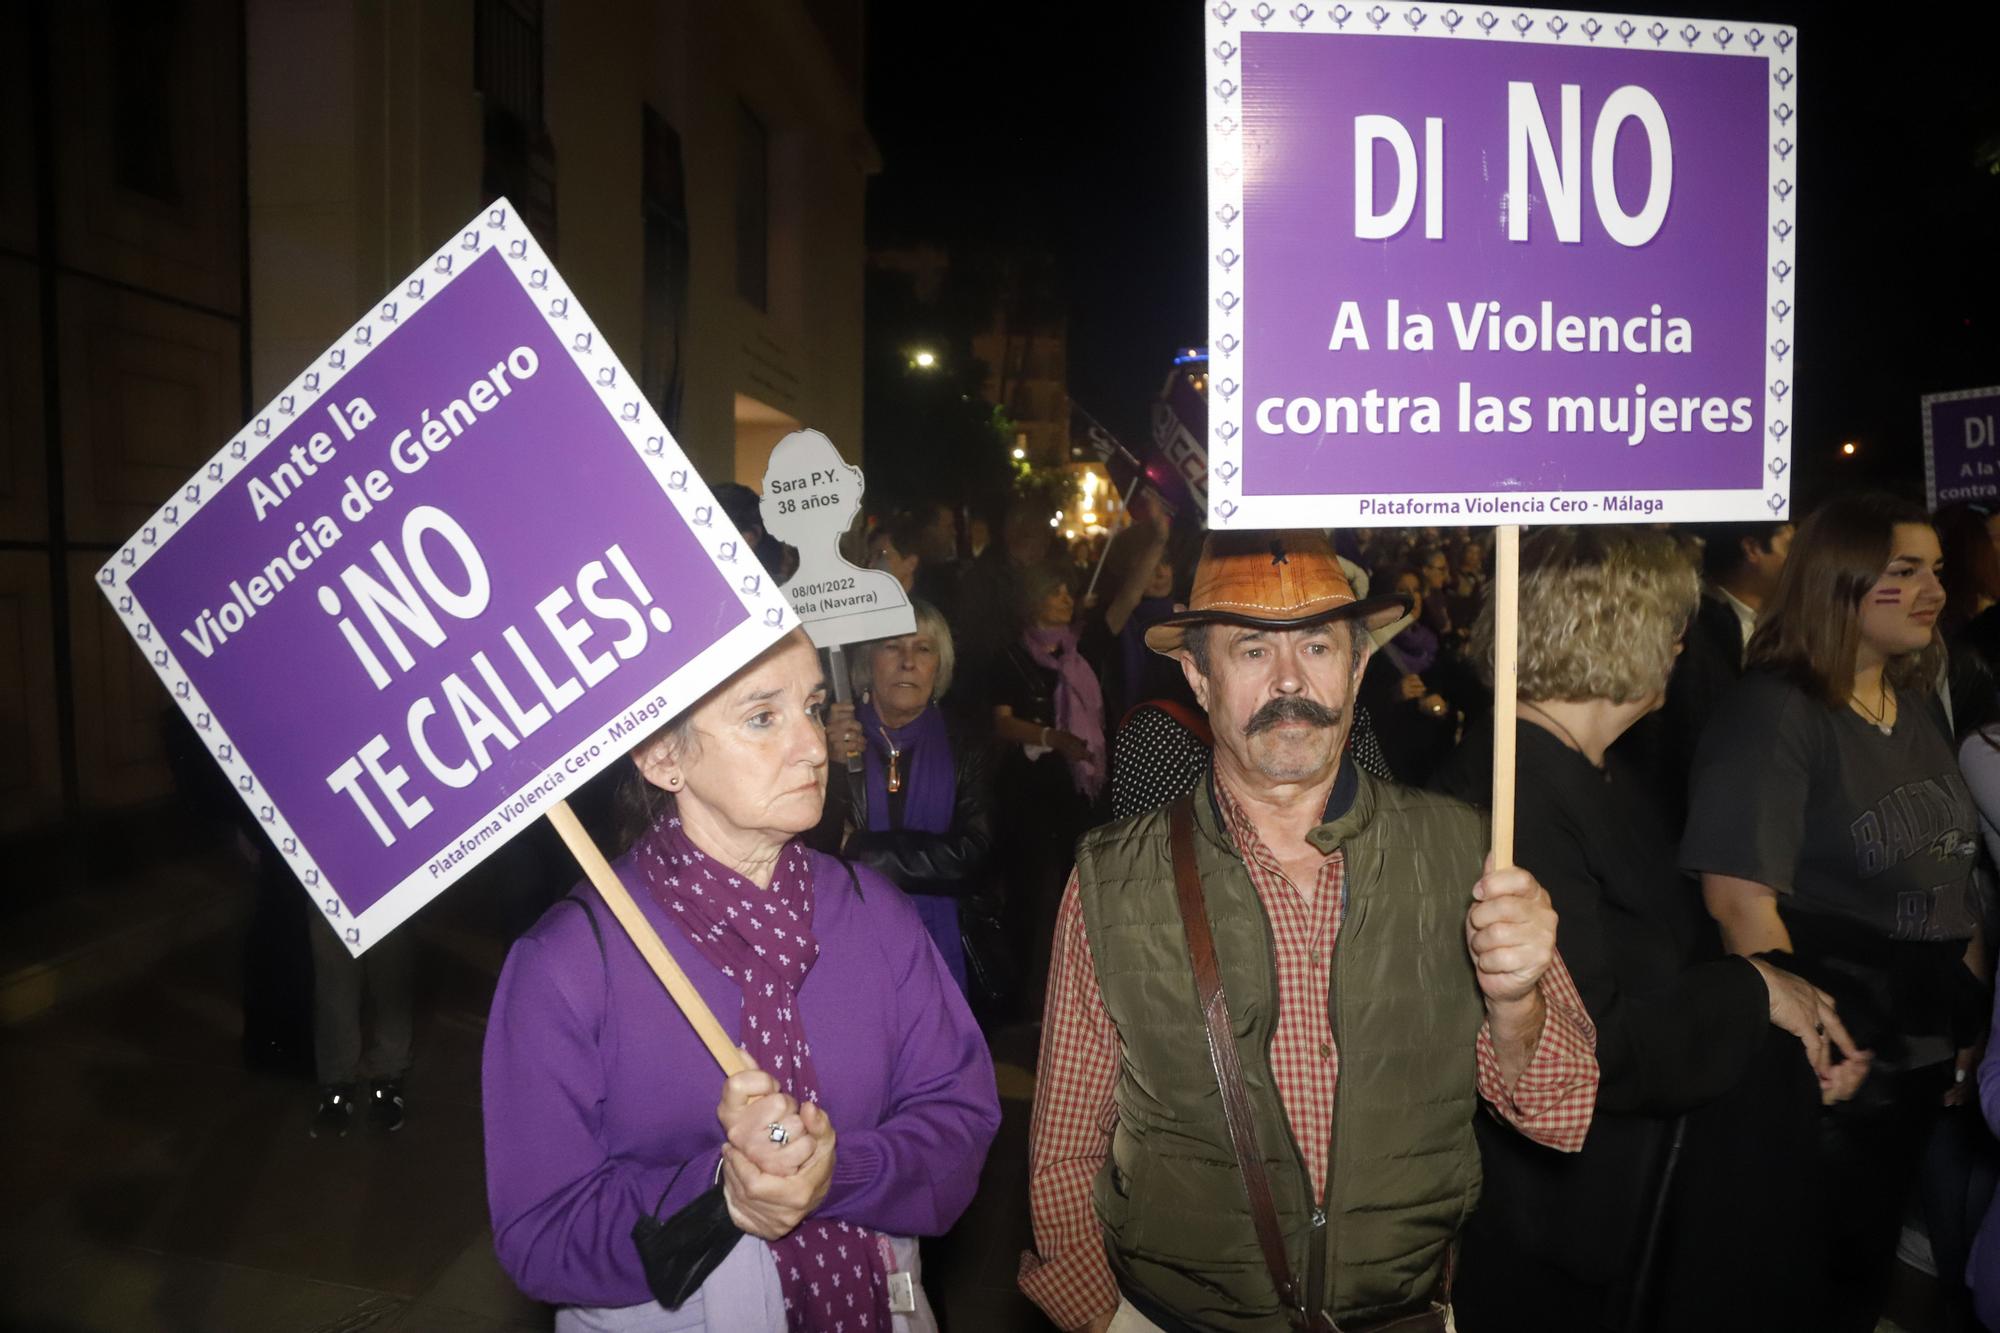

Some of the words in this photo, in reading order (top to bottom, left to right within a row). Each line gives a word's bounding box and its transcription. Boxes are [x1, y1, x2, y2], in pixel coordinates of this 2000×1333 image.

[1355, 114, 1443, 240] DI
[1507, 80, 1673, 247] NO
[1328, 301, 1370, 351] A
[1386, 299, 1434, 352] la
[1446, 300, 1692, 354] Violencia
[1254, 389, 1441, 435] contra
[1458, 382, 1533, 433] las
[1547, 383, 1753, 446] mujeres
[1964, 415, 1996, 449] DI
[247, 433, 337, 521] Ante
[327, 397, 377, 441] la
[1960, 463, 1974, 478] A
[1977, 461, 1994, 476] la
[181, 516, 343, 658] Violencia
[341, 475, 394, 523] de
[389, 345, 539, 474] Género
[771, 478, 807, 495] Sara
[811, 468, 840, 487] P.Y.
[1939, 484, 1998, 501] contra
[778, 499, 796, 515] 38
[801, 493, 840, 511] años
[1359, 498, 1460, 515] Plataforma
[1464, 497, 1545, 514] Violencia
[1549, 496, 1589, 513] Cero
[1602, 495, 1664, 515] Málaga
[317, 505, 491, 691] ¡NO
[791, 577, 856, 599] 08/01/2022
[819, 590, 878, 613] (Navarra)
[326, 733, 434, 847] TE
[406, 543, 673, 789] CALLES!
[428, 820, 502, 879] Plataforma
[497, 769, 566, 823] Violencia
[564, 742, 601, 775] Cero
[607, 693, 668, 743] Málaga
